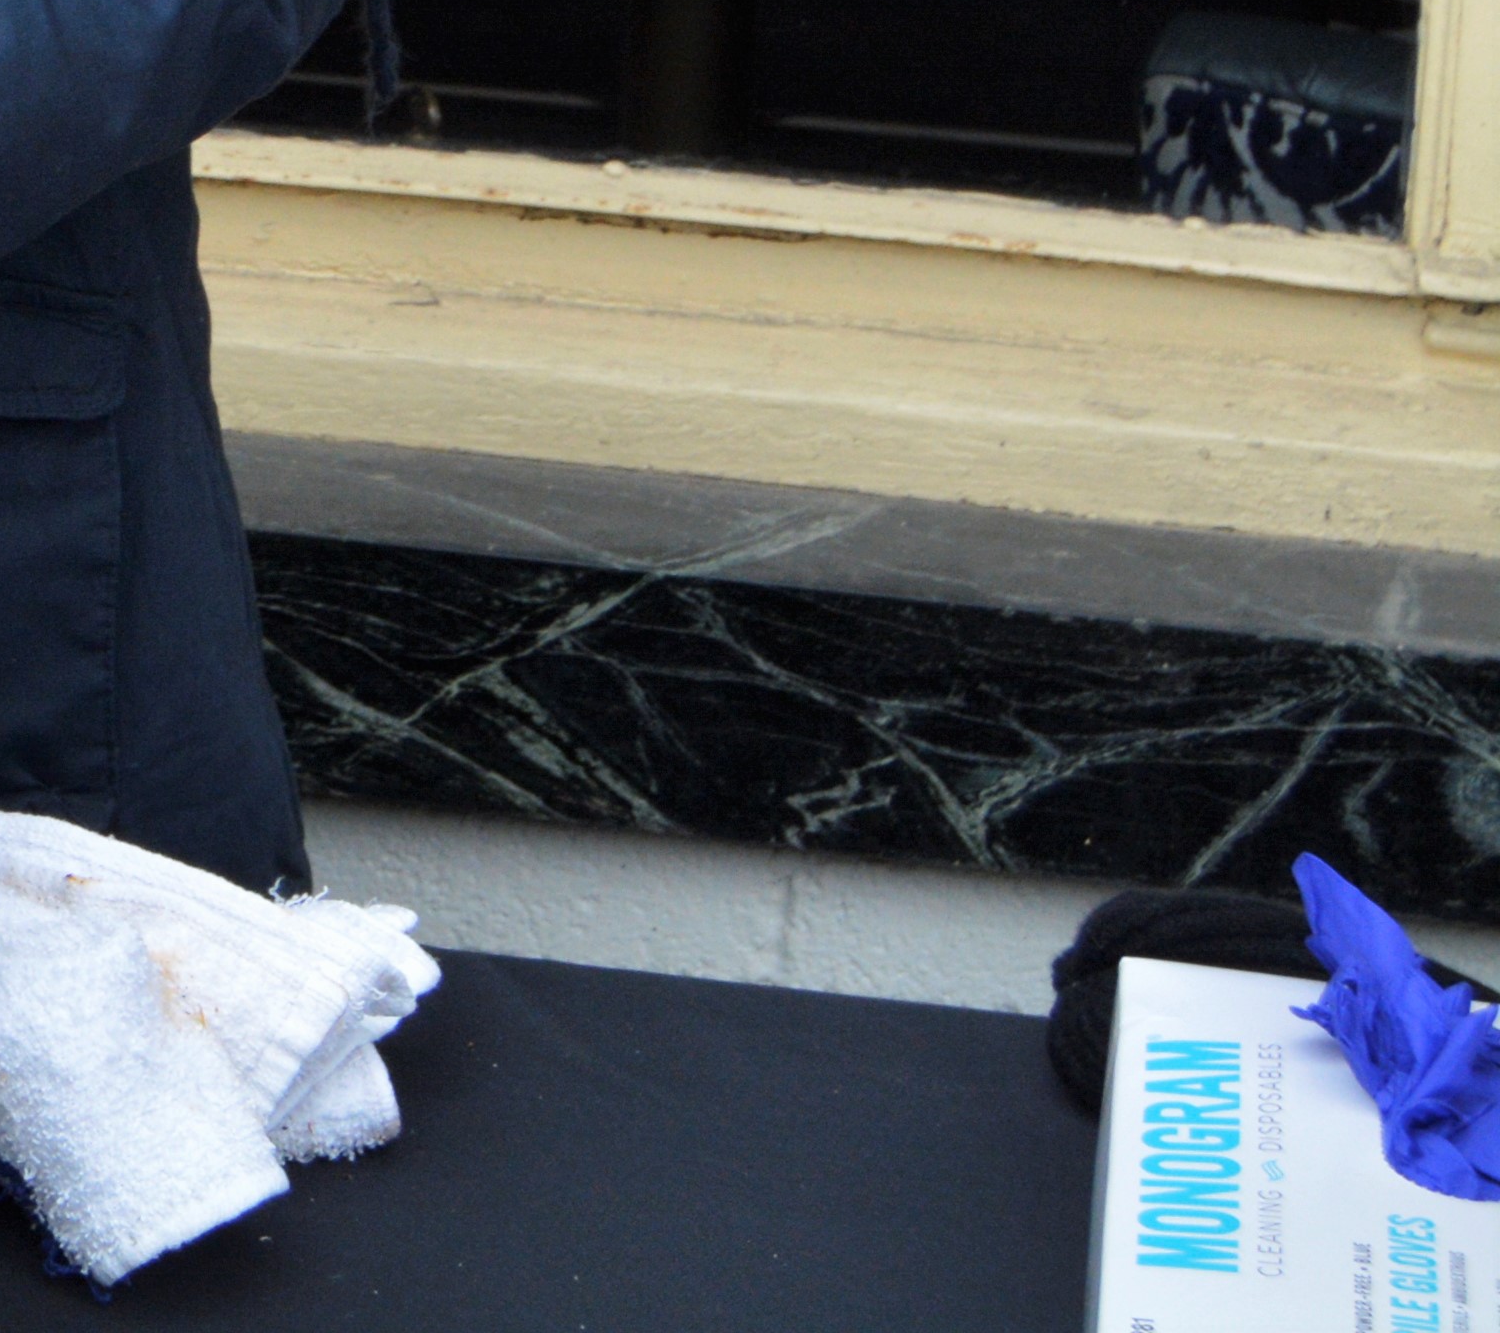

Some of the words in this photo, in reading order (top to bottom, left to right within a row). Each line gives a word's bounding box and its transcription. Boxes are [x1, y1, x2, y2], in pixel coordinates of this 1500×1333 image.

[1258, 1043, 1283, 1152] DISPOSABLES
[1136, 1040, 1241, 1273] MONOGRAM
[1257, 1190, 1283, 1277] CLEANING
[1387, 1214, 1438, 1294] GLOVES
